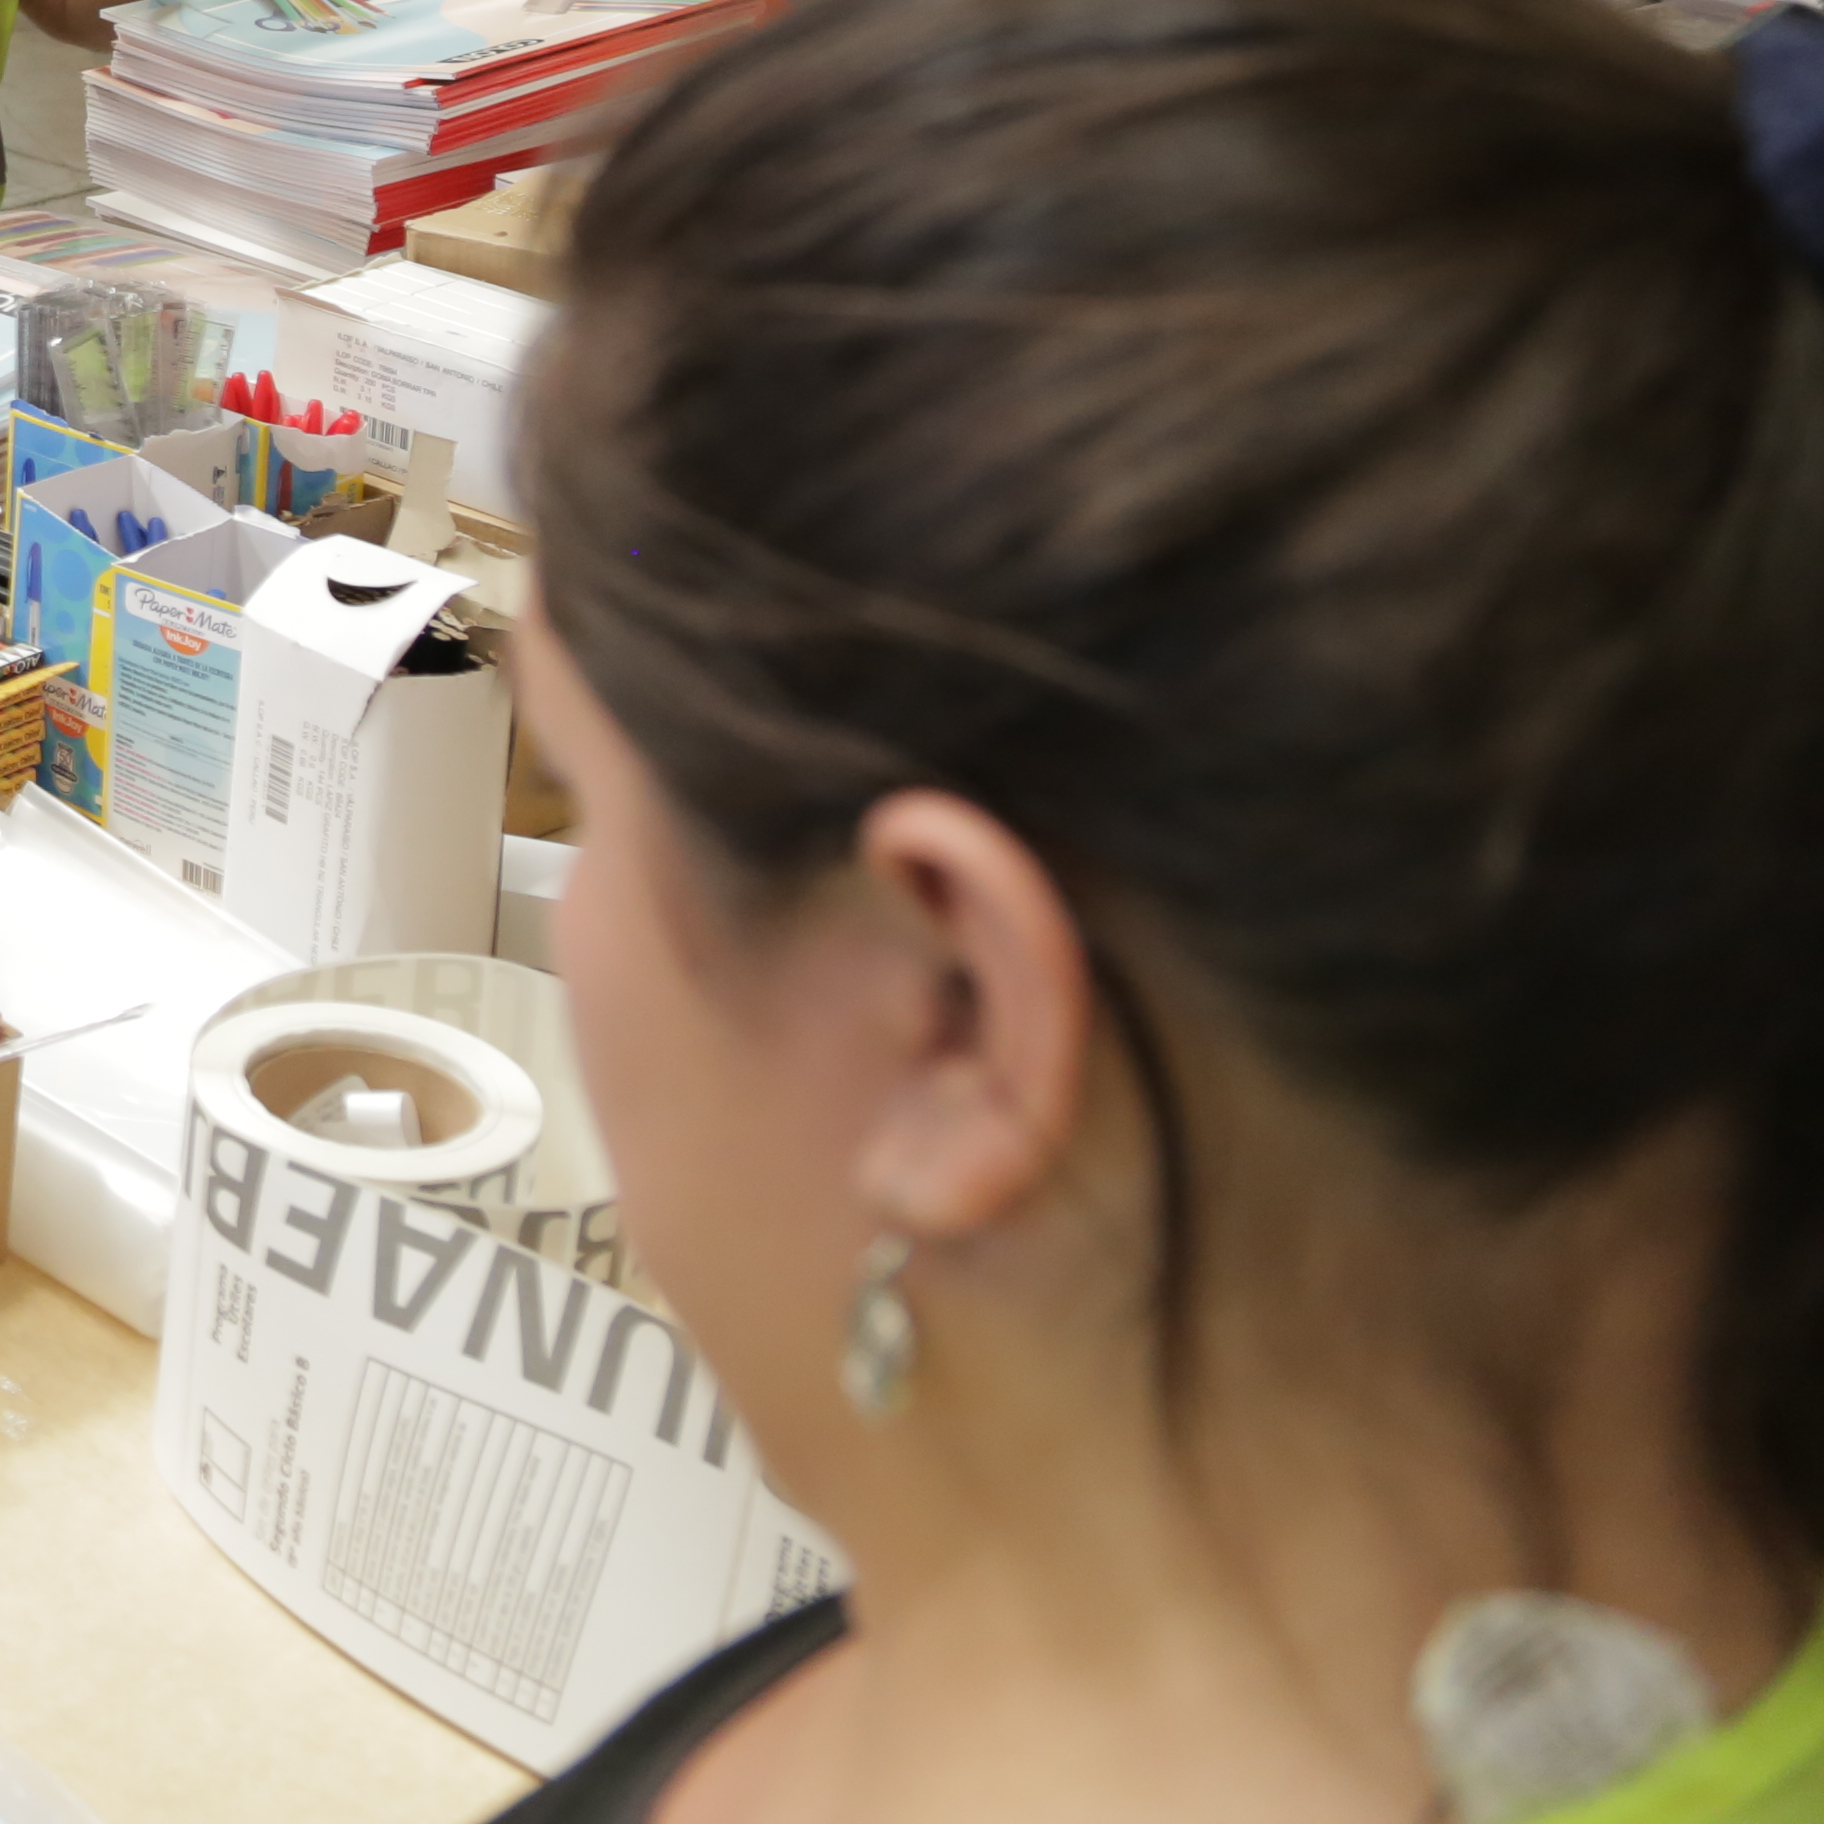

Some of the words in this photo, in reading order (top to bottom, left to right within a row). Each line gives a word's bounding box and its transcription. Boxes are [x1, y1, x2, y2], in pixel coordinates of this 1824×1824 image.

[134, 588, 186, 620] Paper
[193, 612, 238, 639] Mate
[166, 629, 202, 652] InkJoy
[210, 1263, 230, 1344] Programa
[235, 1282, 258, 1364] Escolares
[278, 1435, 298, 1478] Ciclo
[269, 1482, 292, 1555] Segundo
